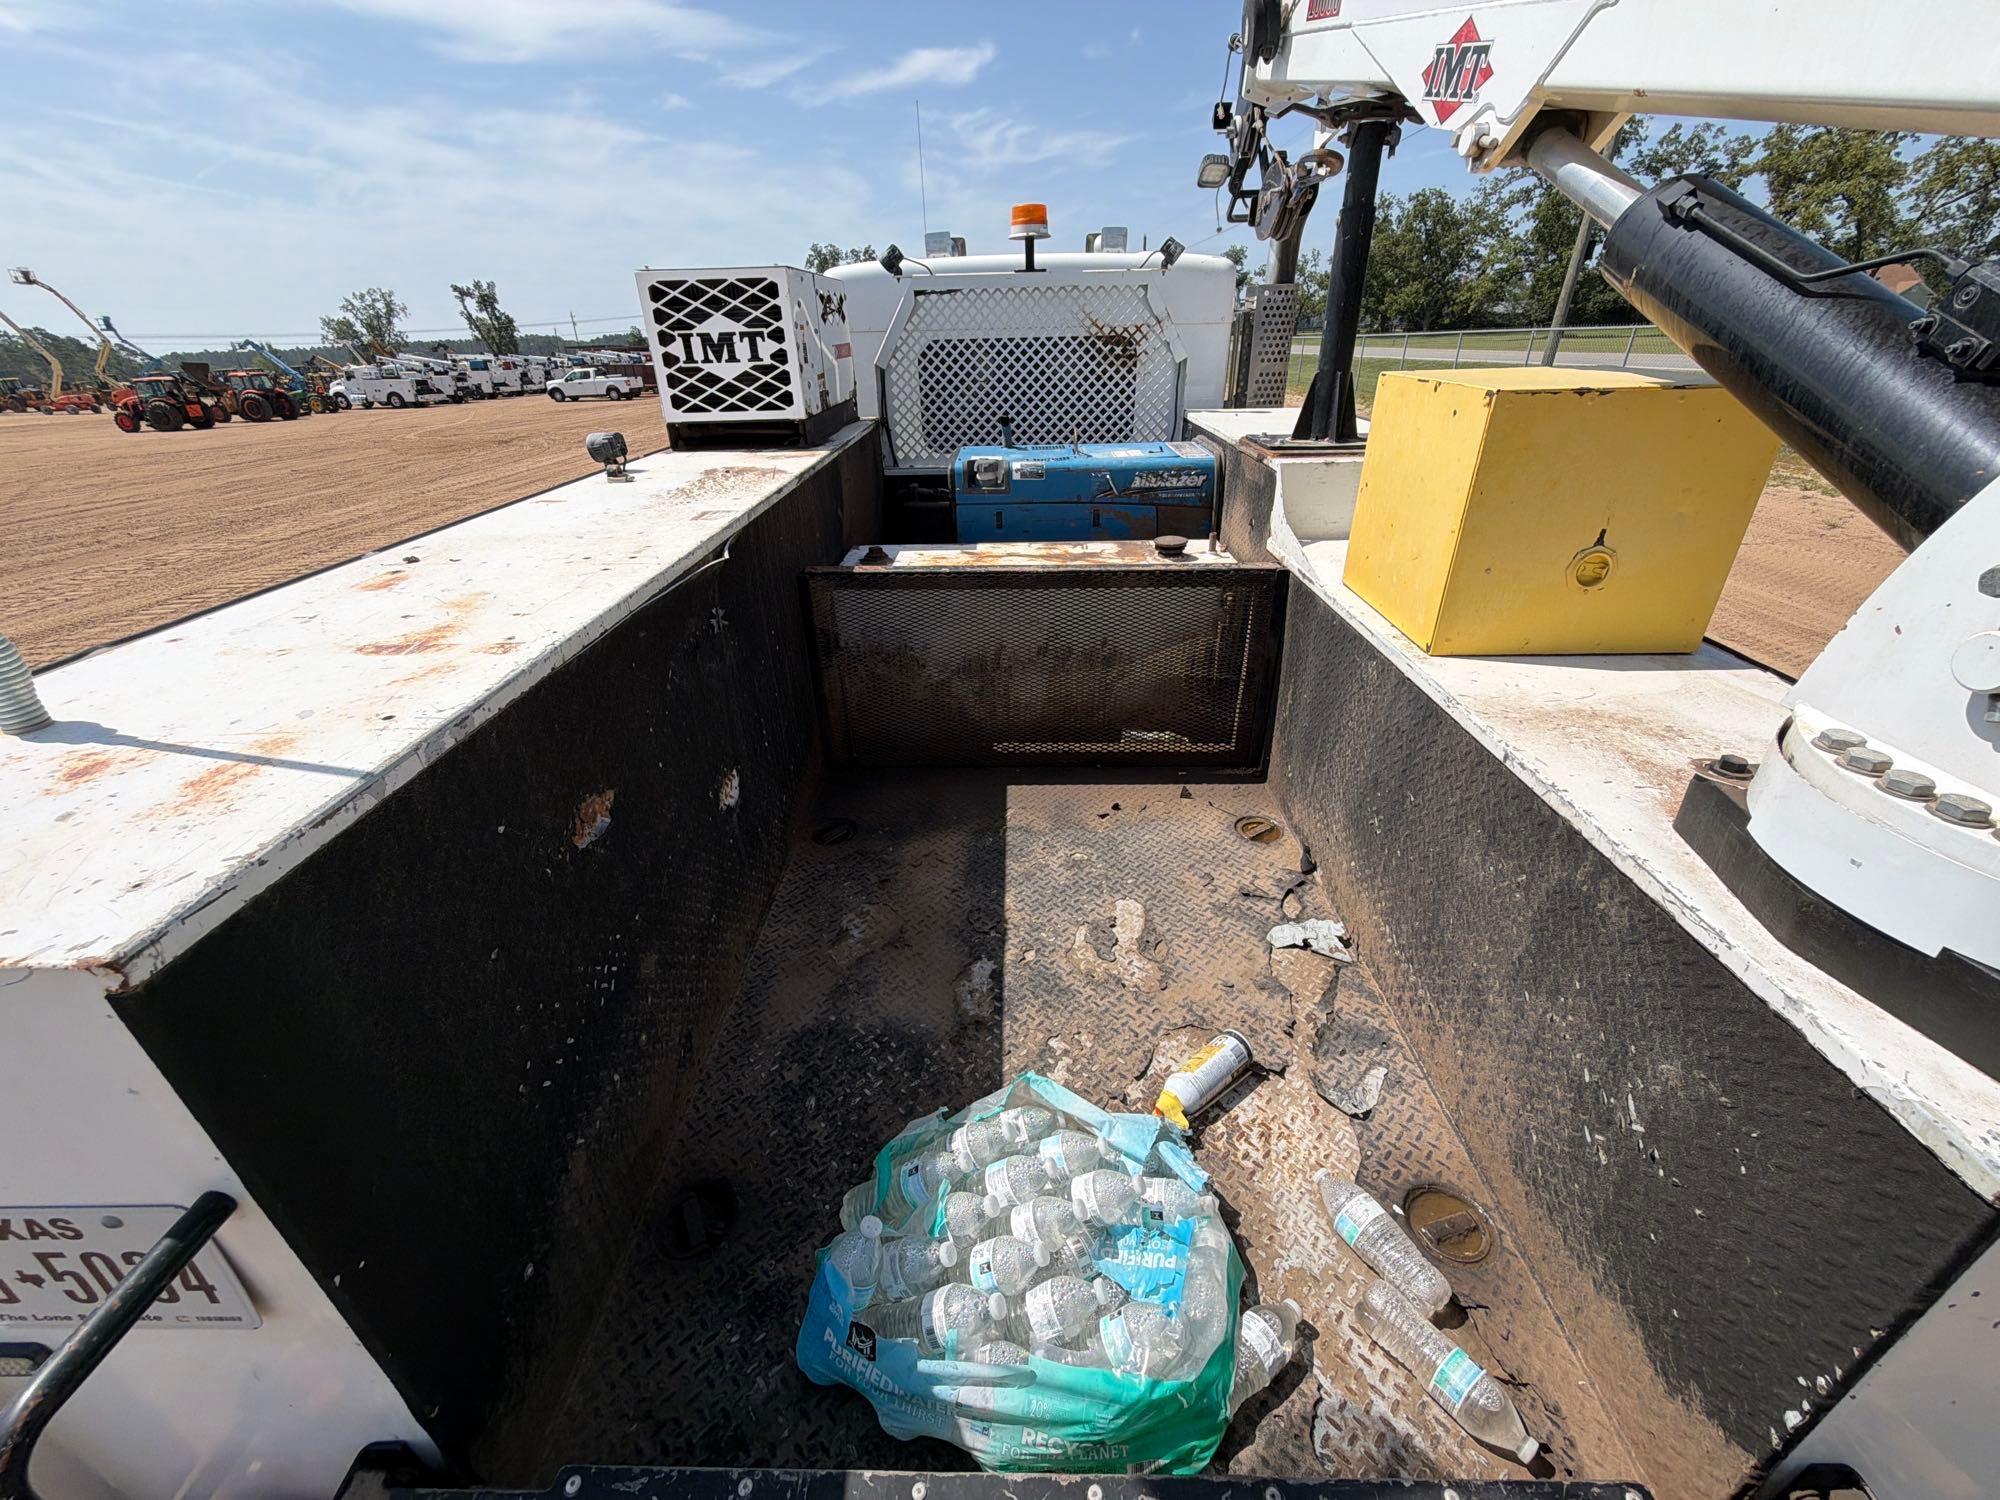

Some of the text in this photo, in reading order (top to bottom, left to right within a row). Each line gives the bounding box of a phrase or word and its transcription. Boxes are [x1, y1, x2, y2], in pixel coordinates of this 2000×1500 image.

[1423, 42, 1492, 101] IMT
[677, 331, 766, 364] IMT
[824, 1327, 893, 1393] PURIFIED
